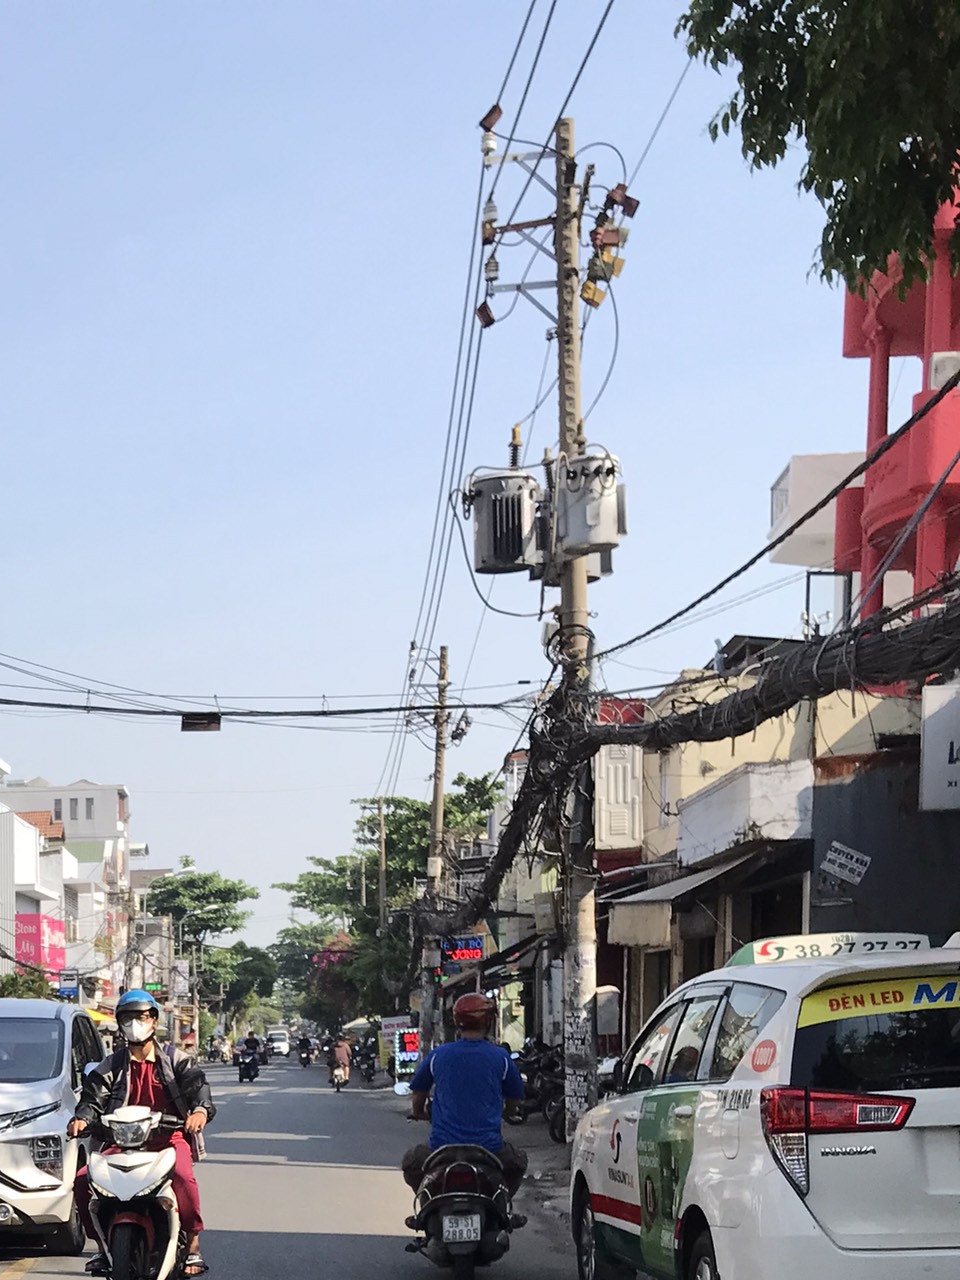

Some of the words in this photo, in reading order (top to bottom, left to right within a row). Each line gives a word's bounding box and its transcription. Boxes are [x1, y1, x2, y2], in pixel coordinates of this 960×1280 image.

[828, 993, 865, 1012] ĐÈN
[870, 990, 905, 1006] LED
[820, 1145, 876, 1157] INNOVA
[444, 1228, 479, 1240] 288.05
